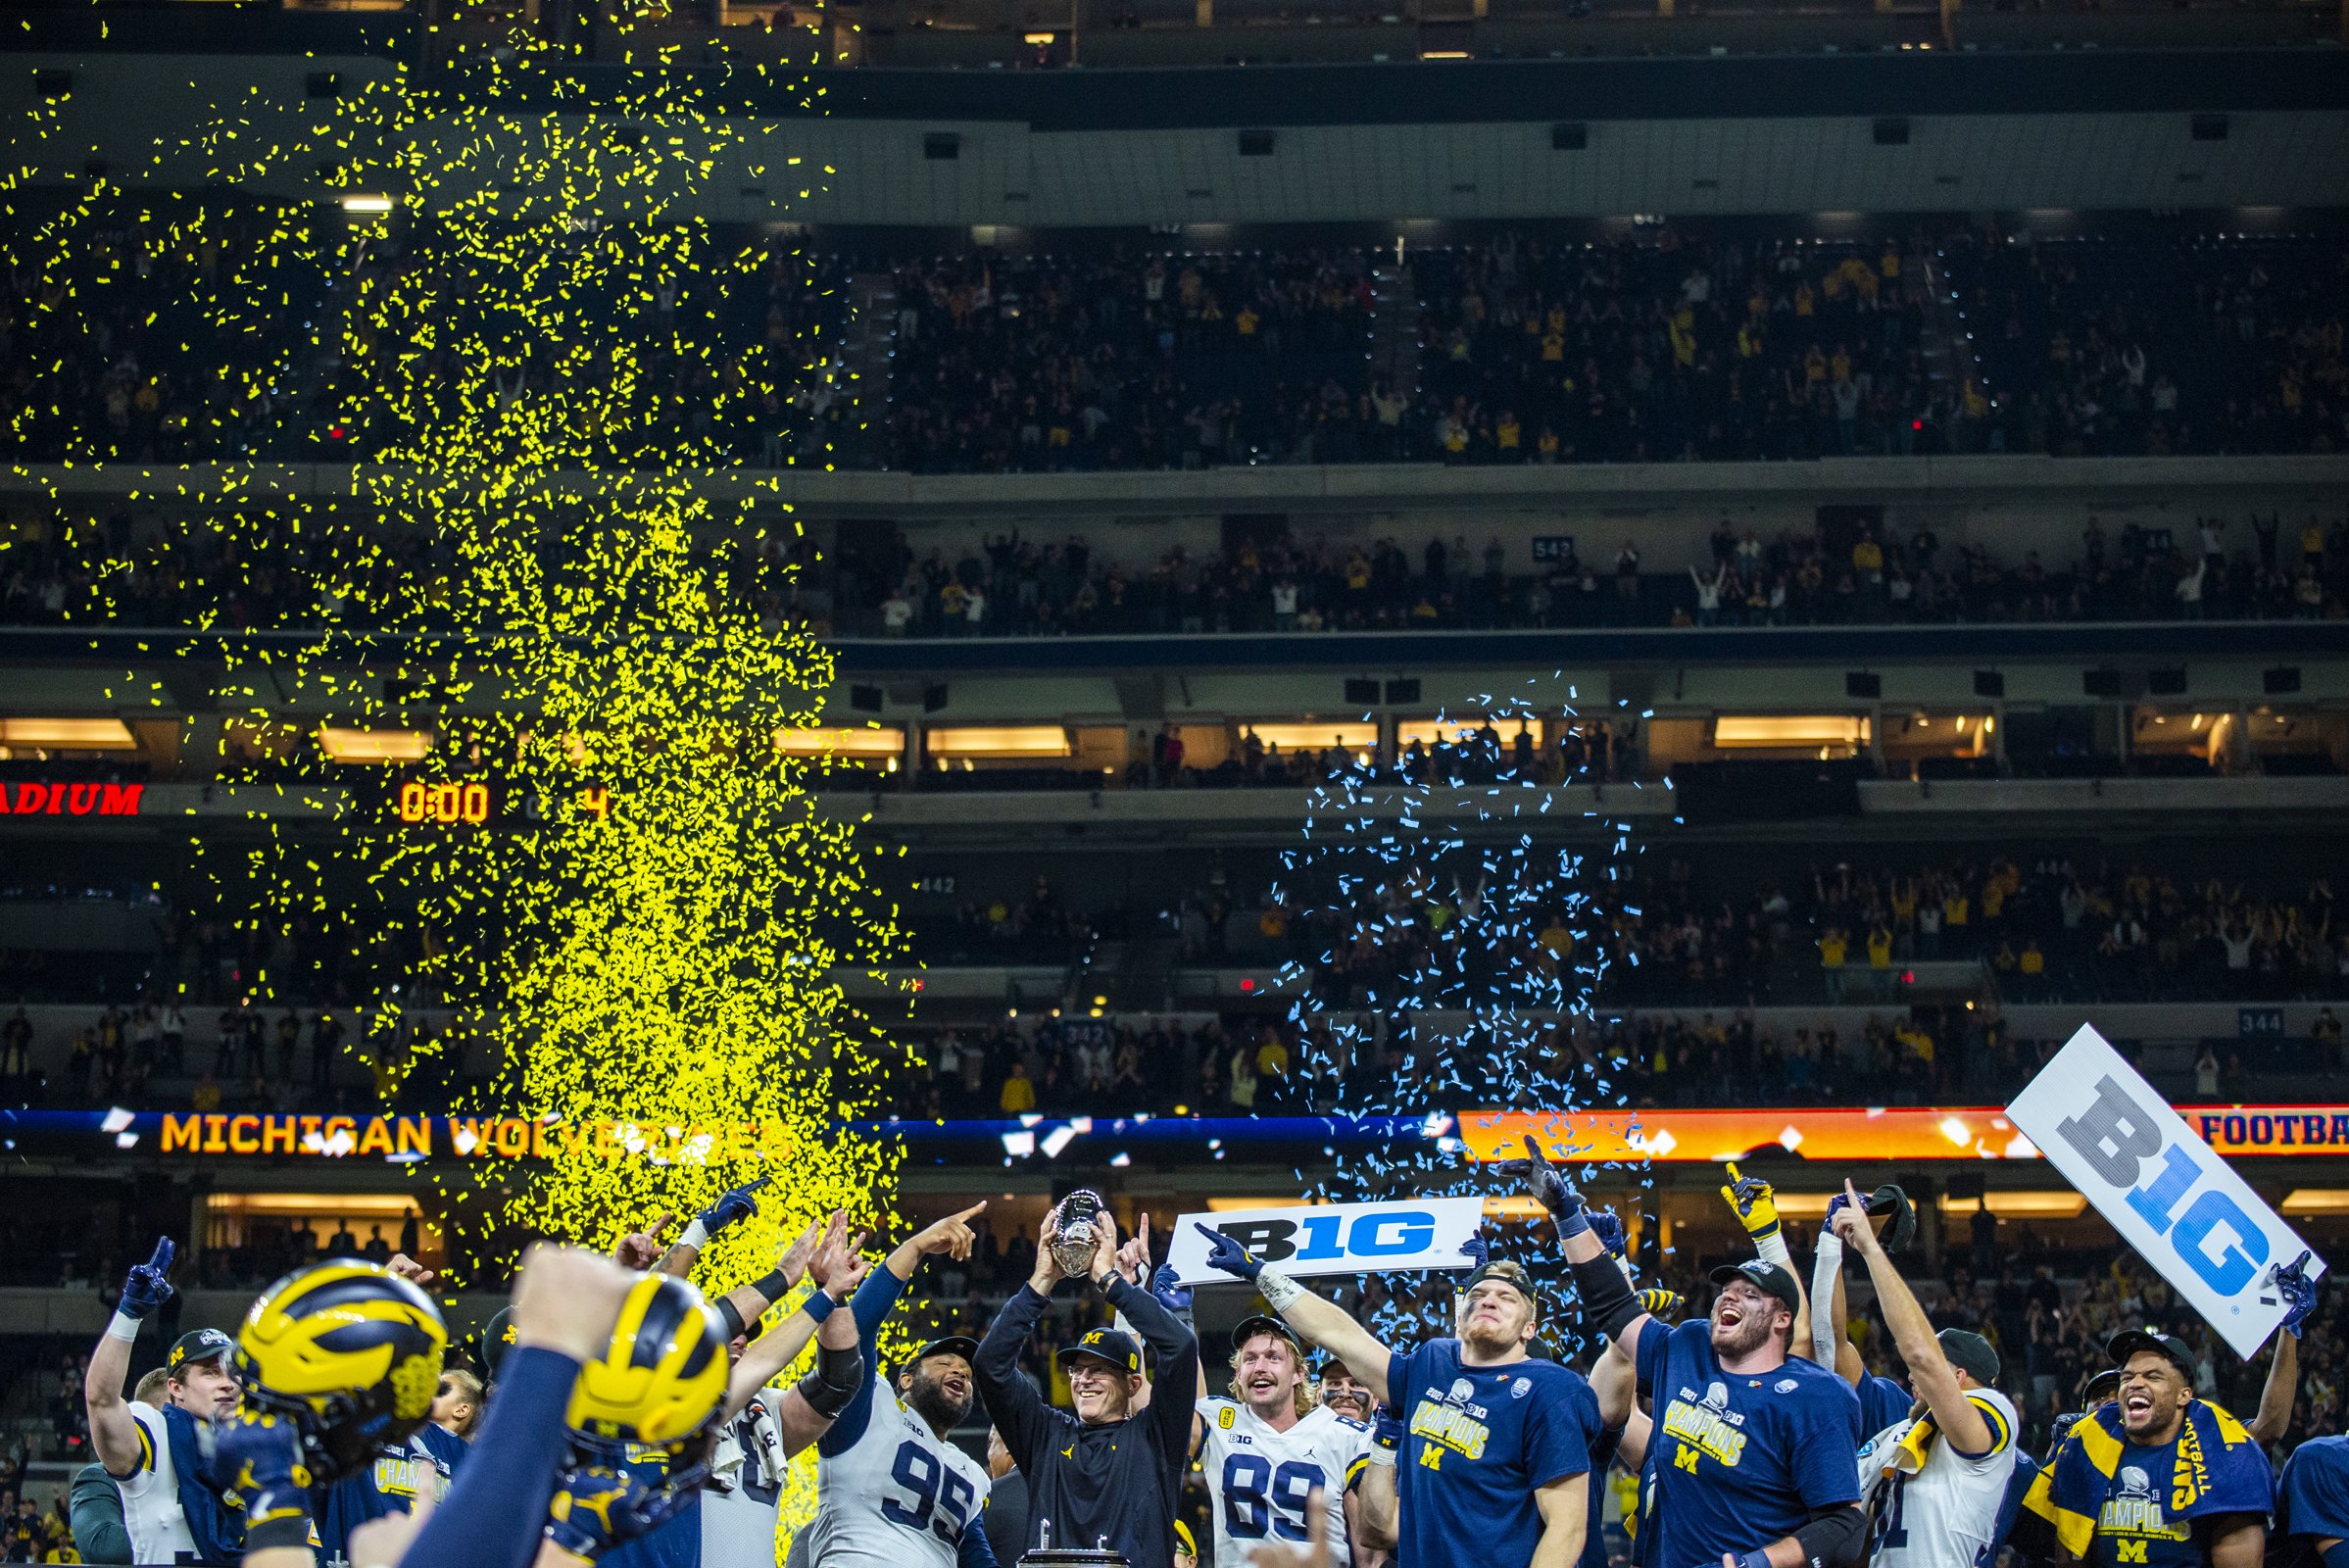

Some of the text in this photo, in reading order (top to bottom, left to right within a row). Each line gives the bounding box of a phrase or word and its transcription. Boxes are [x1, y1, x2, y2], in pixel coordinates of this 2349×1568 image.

[402, 783, 488, 822] 0:00
[2242, 1014, 2279, 1032] 344
[161, 1114, 431, 1154] MICHIGAN
[1082, 1332, 1104, 1345] M
[1426, 1387, 1444, 1401] 2021
[1679, 1386, 1698, 1402] 2021
[1420, 1442, 1445, 1471] M
[1674, 1443, 1700, 1475] M
[2184, 1417, 2212, 1495] OTBALL
[881, 1440, 975, 1551] 95
[1222, 1453, 1326, 1543] 89
[2098, 1500, 2191, 1542] AMPIOS
[2117, 1539, 2148, 1563] M
